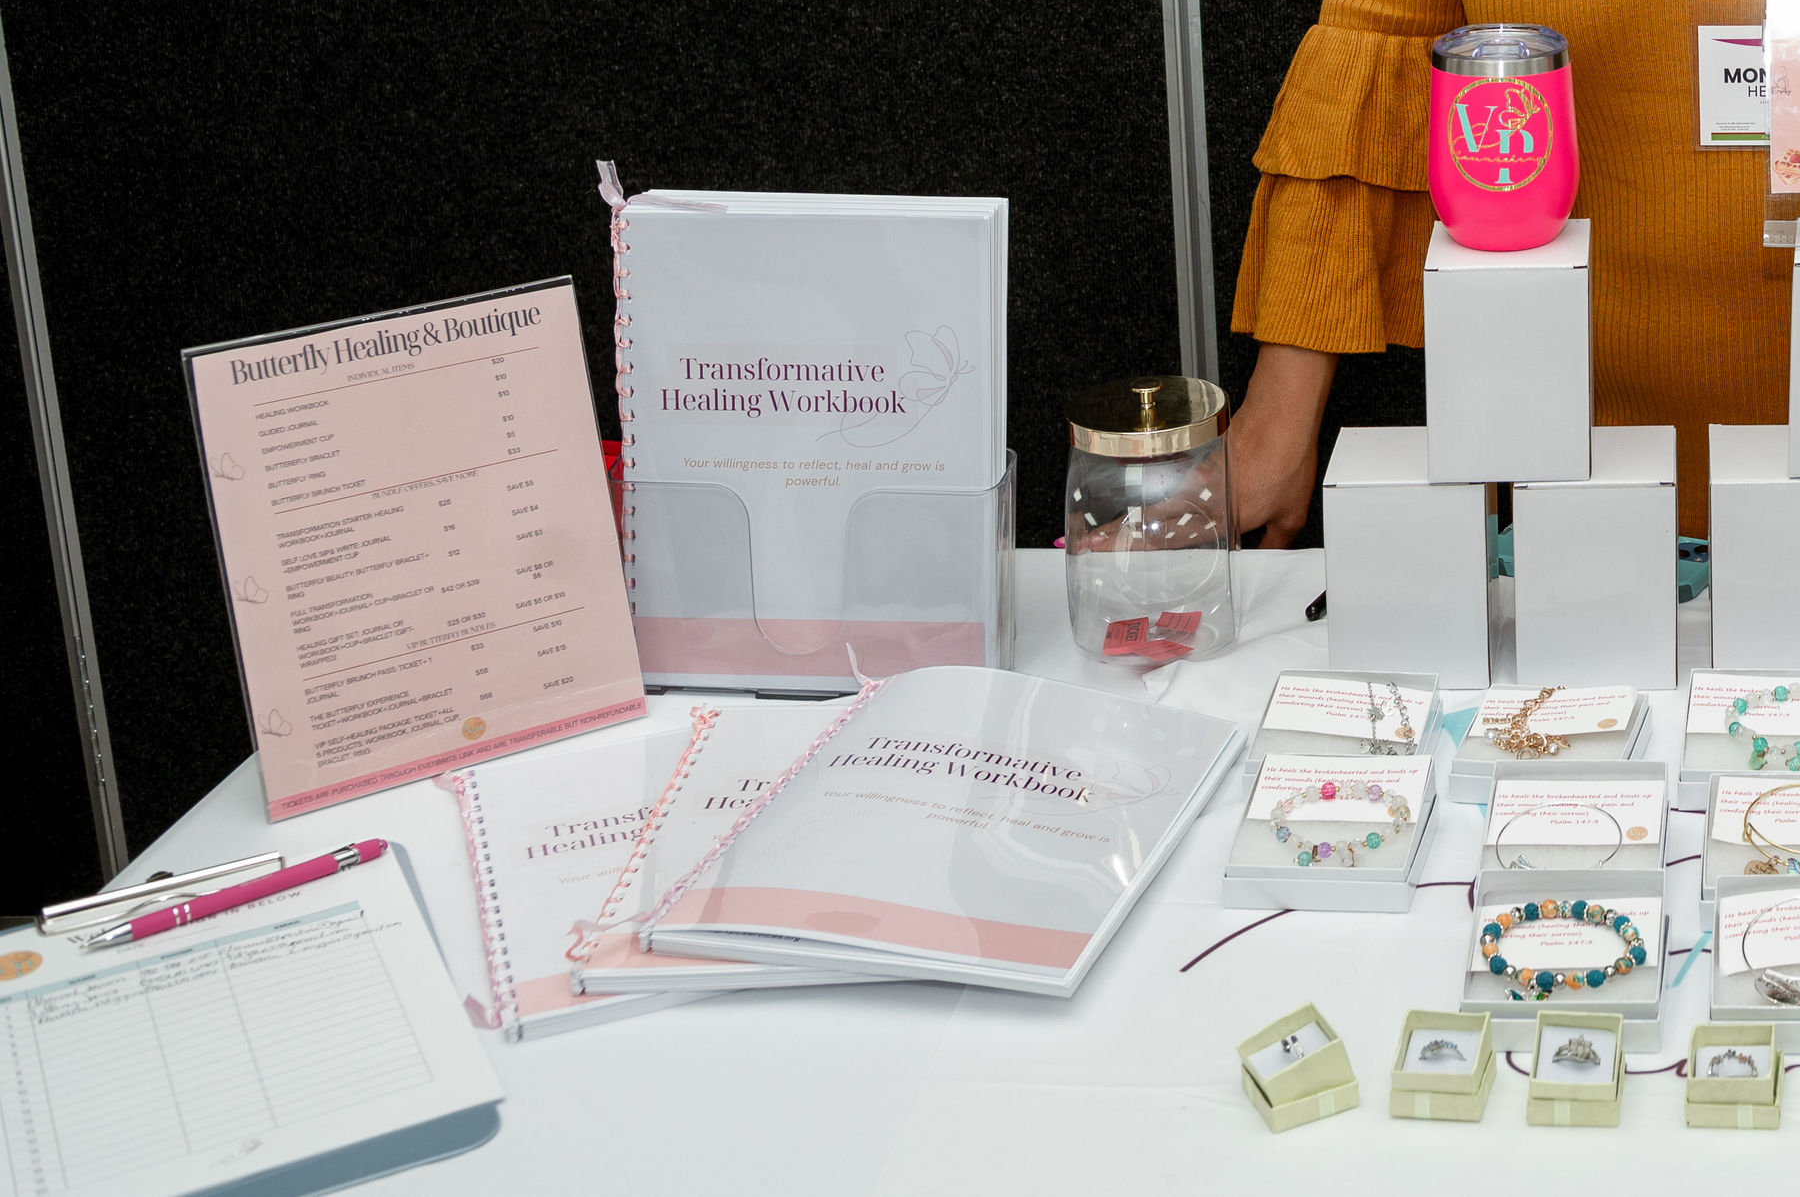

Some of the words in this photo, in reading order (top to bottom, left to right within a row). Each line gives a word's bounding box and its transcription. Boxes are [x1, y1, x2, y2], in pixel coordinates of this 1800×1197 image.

[230, 344, 330, 385] Butterfly
[334, 330, 422, 364] Healing
[423, 322, 443, 346] &
[443, 306, 541, 343] Boutique
[491, 357, 504, 365] $20
[680, 357, 884, 382] Transformative
[347, 367, 390, 382] INDIVIDUAL
[390, 362, 415, 373] ITEMS
[495, 373, 507, 381] $10
[498, 390, 510, 398] $10
[660, 388, 762, 418] Healing
[768, 389, 908, 414] Workbook
[255, 408, 286, 420] HEALING
[287, 400, 329, 415] WORKBOOK
[502, 414, 514, 422] $10
[258, 426, 285, 437] GUIDED
[287, 420, 318, 433] JOURNAL
[261, 436, 318, 455] EMPOWERMENT
[320, 433, 334, 443] CUP
[507, 447, 520, 455] $33
[264, 457, 308, 472] BUTTEREFLY
[309, 450, 340, 463] BRACLET
[684, 457, 709, 468] Your
[713, 458, 778, 471] willingness
[783, 460, 795, 470] to
[799, 459, 842, 472] reflect,
[846, 460, 872, 470] heal
[876, 460, 898, 471] and
[901, 462, 931, 473] grow
[935, 462, 945, 472] is
[268, 475, 307, 490] BUTTERFLY
[308, 471, 326, 480] RING
[785, 476, 841, 488] powerful.
[271, 492, 309, 507] BUTTERFLY
[311, 486, 340, 498] BRUNCH
[342, 479, 366, 491] TICKET
[866, 736, 1082, 782] Transformative
[828, 754, 940, 776] Healing
[946, 761, 1094, 804] Workbook
[854, 791, 929, 808] willingness
[931, 801, 946, 810] to
[1000, 815, 1031, 828] heal
[1033, 822, 1060, 834] and
[1061, 829, 1097, 844] grow
[1099, 835, 1110, 844] is
[926, 812, 989, 830] powerful.
